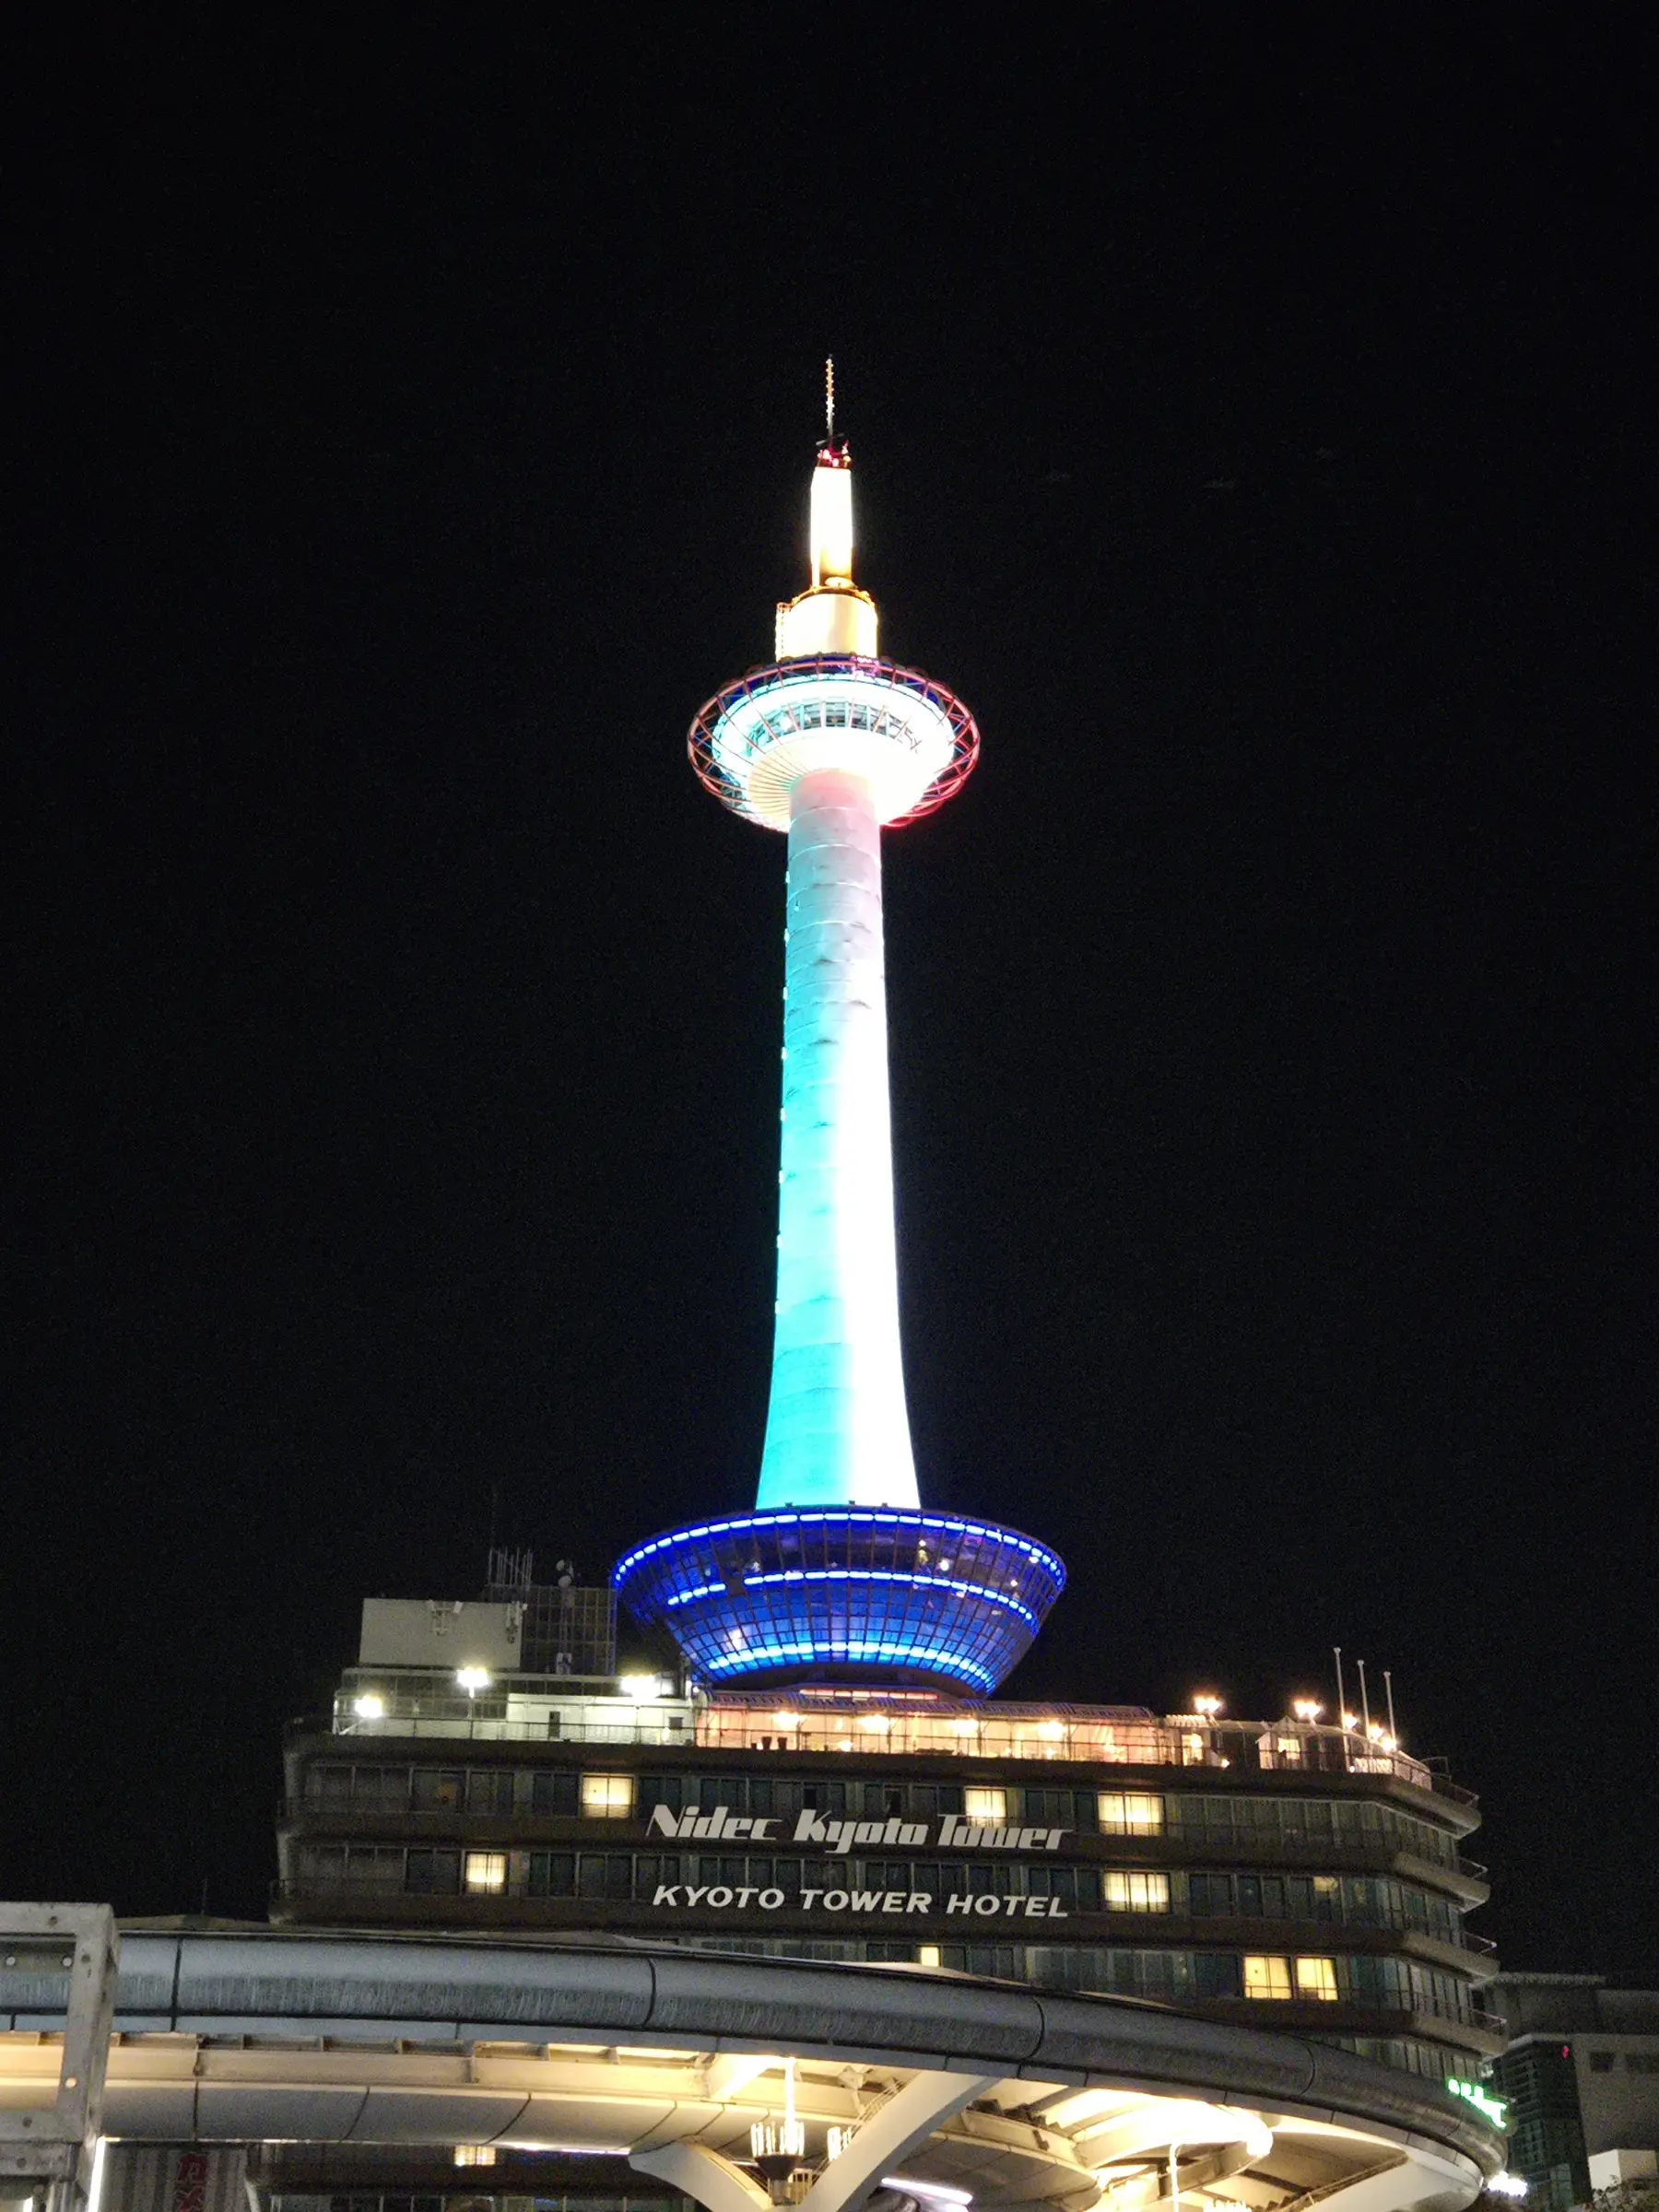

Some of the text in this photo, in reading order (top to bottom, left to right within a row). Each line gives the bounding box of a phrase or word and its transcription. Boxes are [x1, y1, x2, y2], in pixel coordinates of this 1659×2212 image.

[646, 1804, 1074, 1853] Nidec Kyoto Tower
[653, 1885, 1069, 1918] KYOTO TOWER HOTEL
